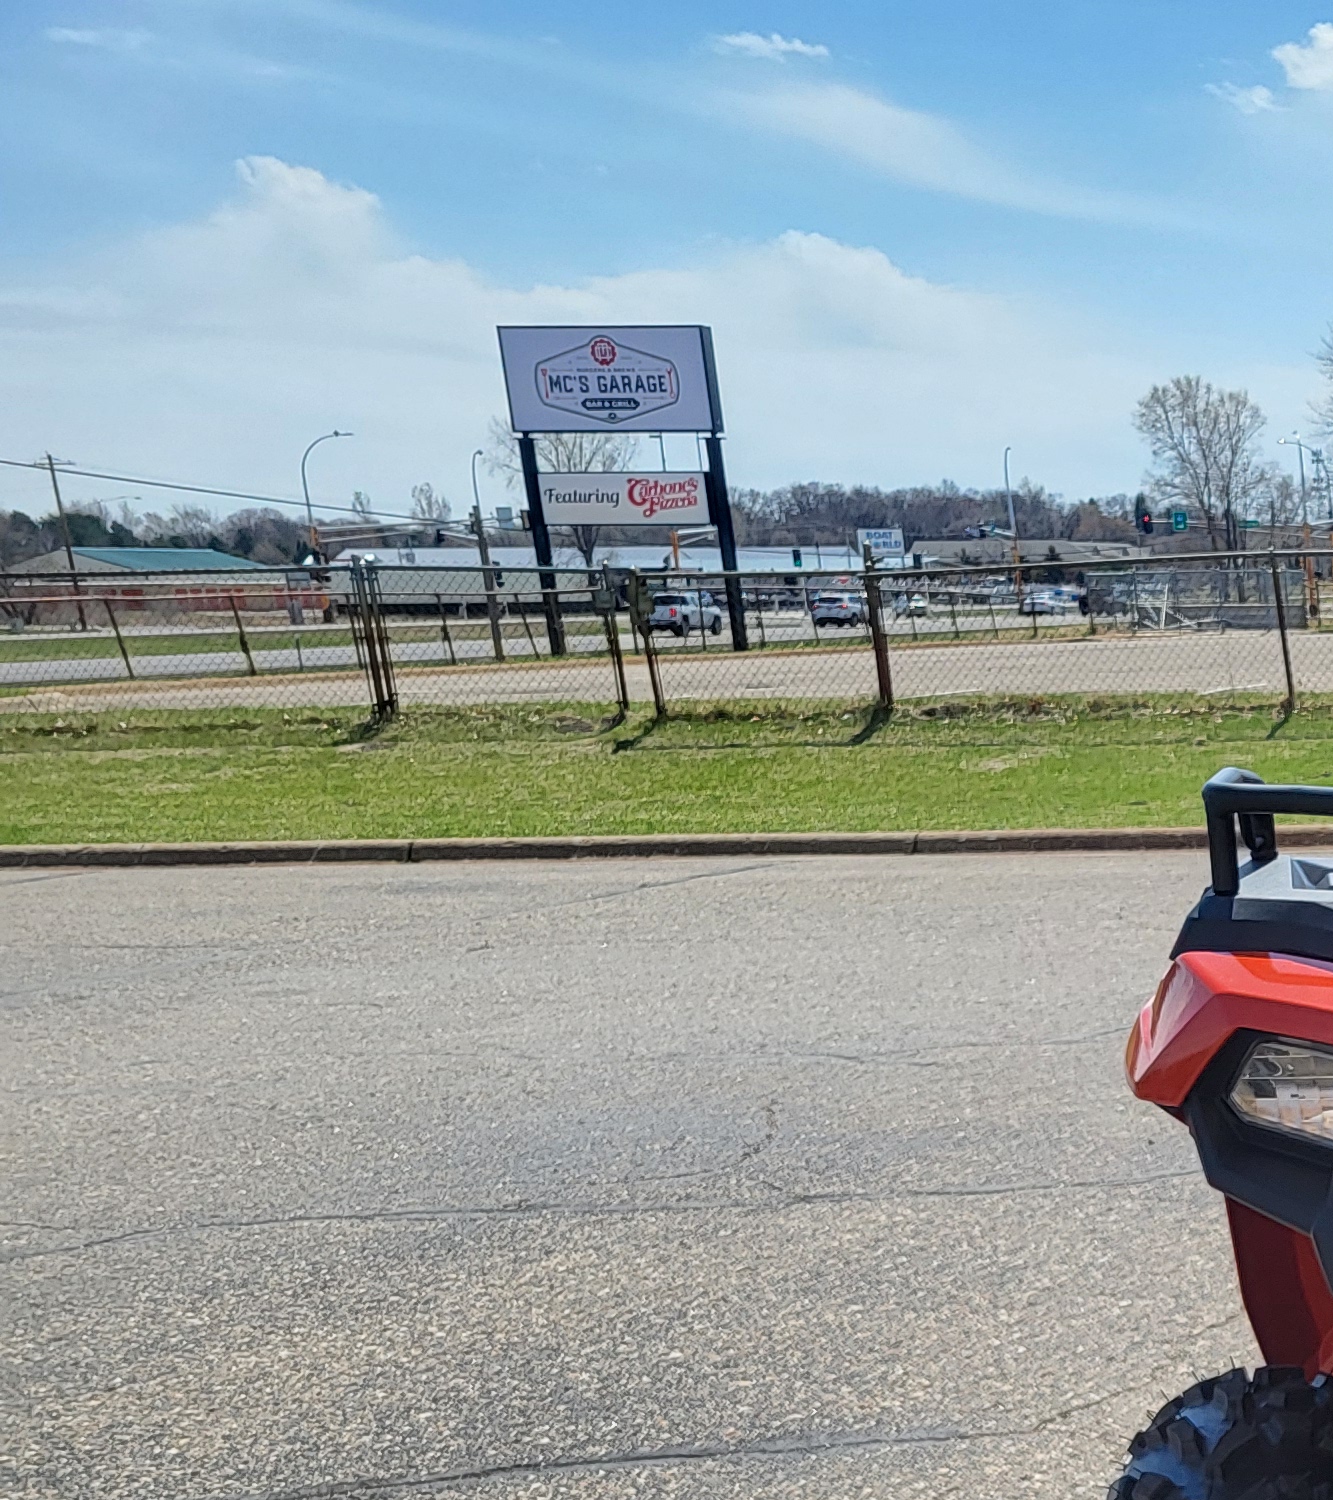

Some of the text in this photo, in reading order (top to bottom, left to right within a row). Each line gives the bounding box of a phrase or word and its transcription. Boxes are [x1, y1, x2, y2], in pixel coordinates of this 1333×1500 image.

[548, 374, 668, 394] MC'S GARAGE
[543, 487, 620, 509] Featuring
[642, 495, 698, 519] Pizzeria
[866, 531, 893, 540] BOAT
